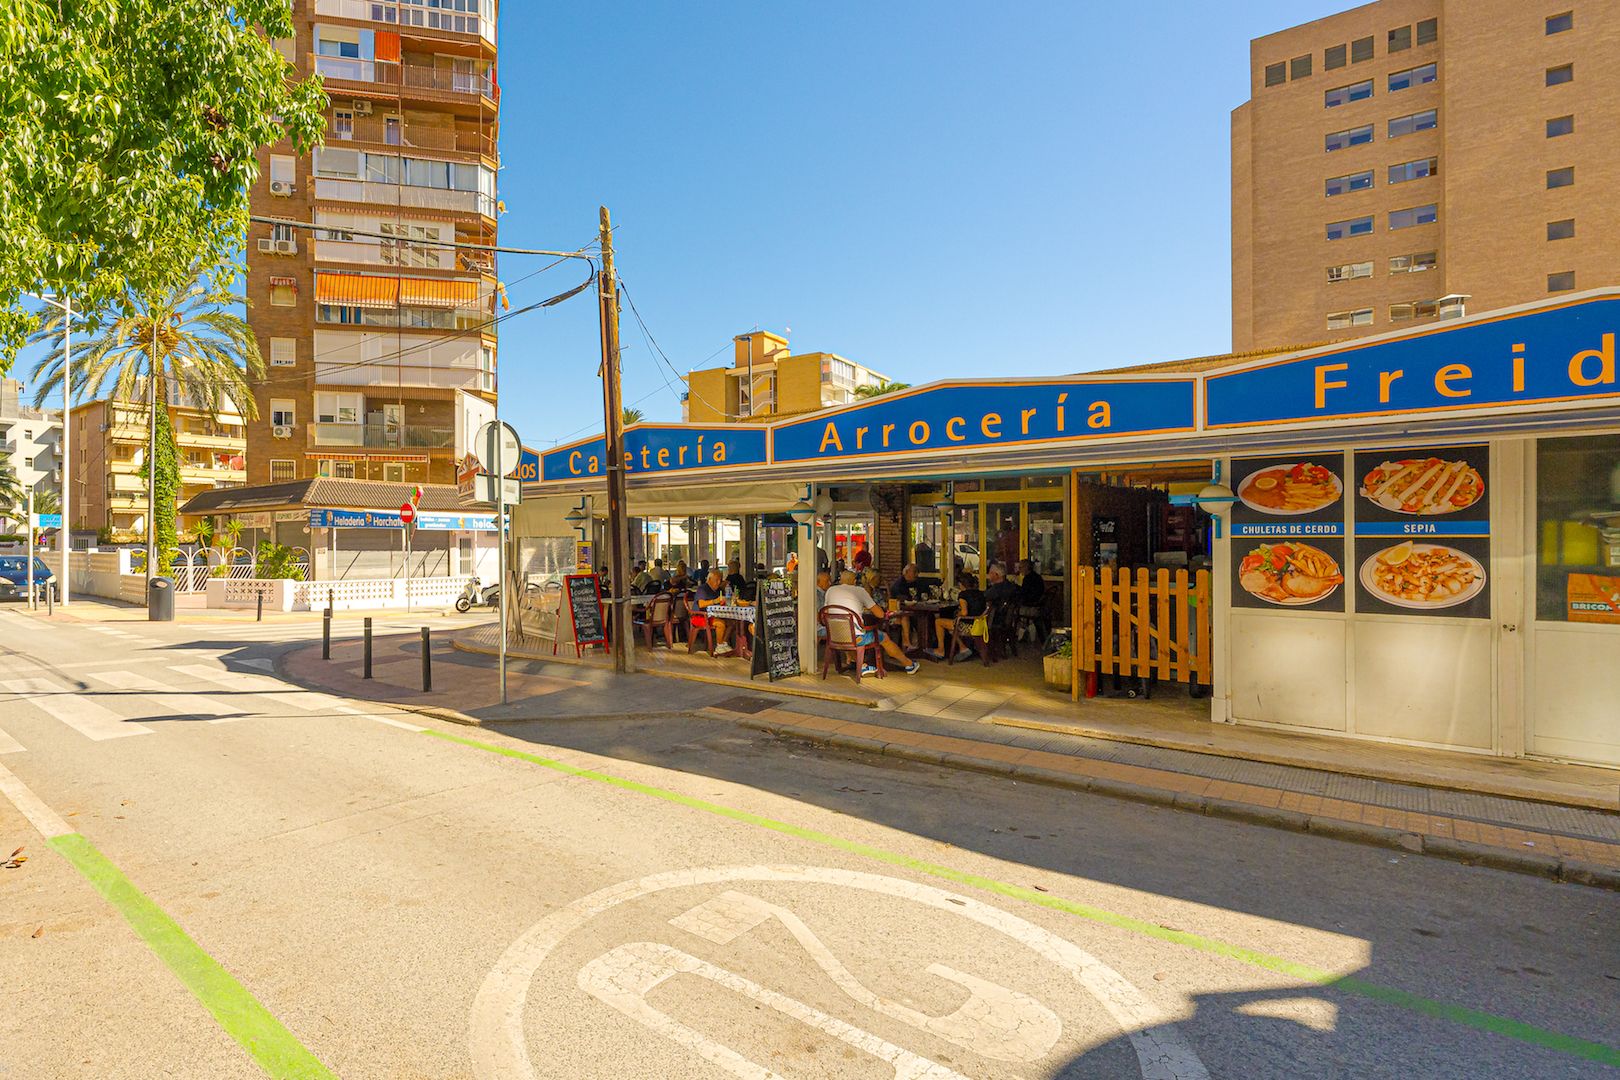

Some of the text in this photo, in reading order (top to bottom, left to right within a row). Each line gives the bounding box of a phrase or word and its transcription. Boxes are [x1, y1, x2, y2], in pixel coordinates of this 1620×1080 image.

[1314, 333, 1615, 408] Freid
[819, 393, 1111, 451] Arrocería
[569, 436, 726, 475] Caetería
[1242, 525, 1337, 534] CHULETAS DE CERDO
[1404, 525, 1436, 533] SEPIA
